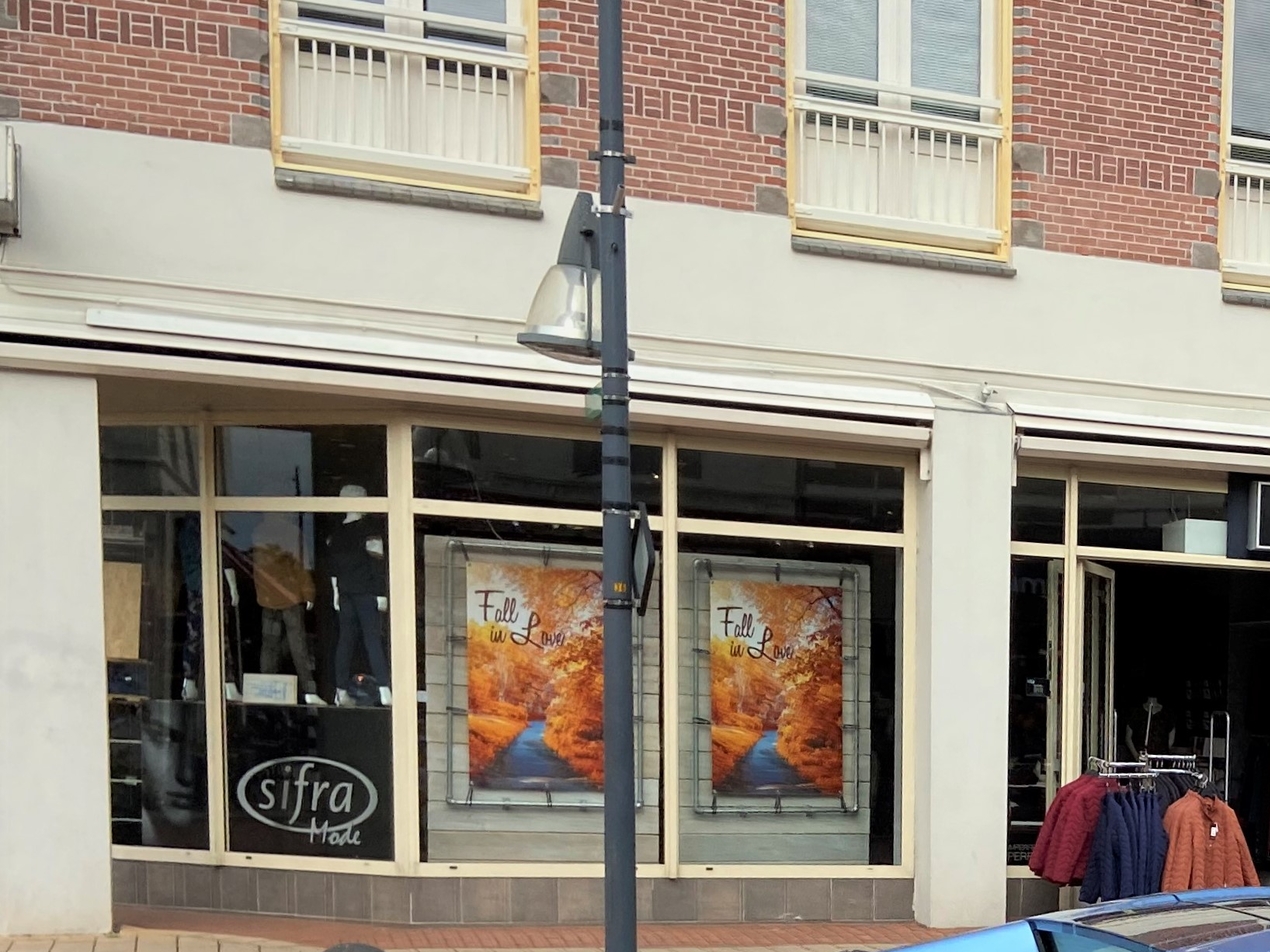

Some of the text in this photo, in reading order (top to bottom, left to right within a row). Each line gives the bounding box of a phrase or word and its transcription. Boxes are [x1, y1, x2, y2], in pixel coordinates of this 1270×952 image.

[474, 588, 518, 624] Fall
[717, 606, 755, 638] Fall
[490, 611, 566, 649] in Love
[730, 627, 795, 662] in Love
[258, 762, 354, 825] sifra
[309, 816, 362, 846] Mode
